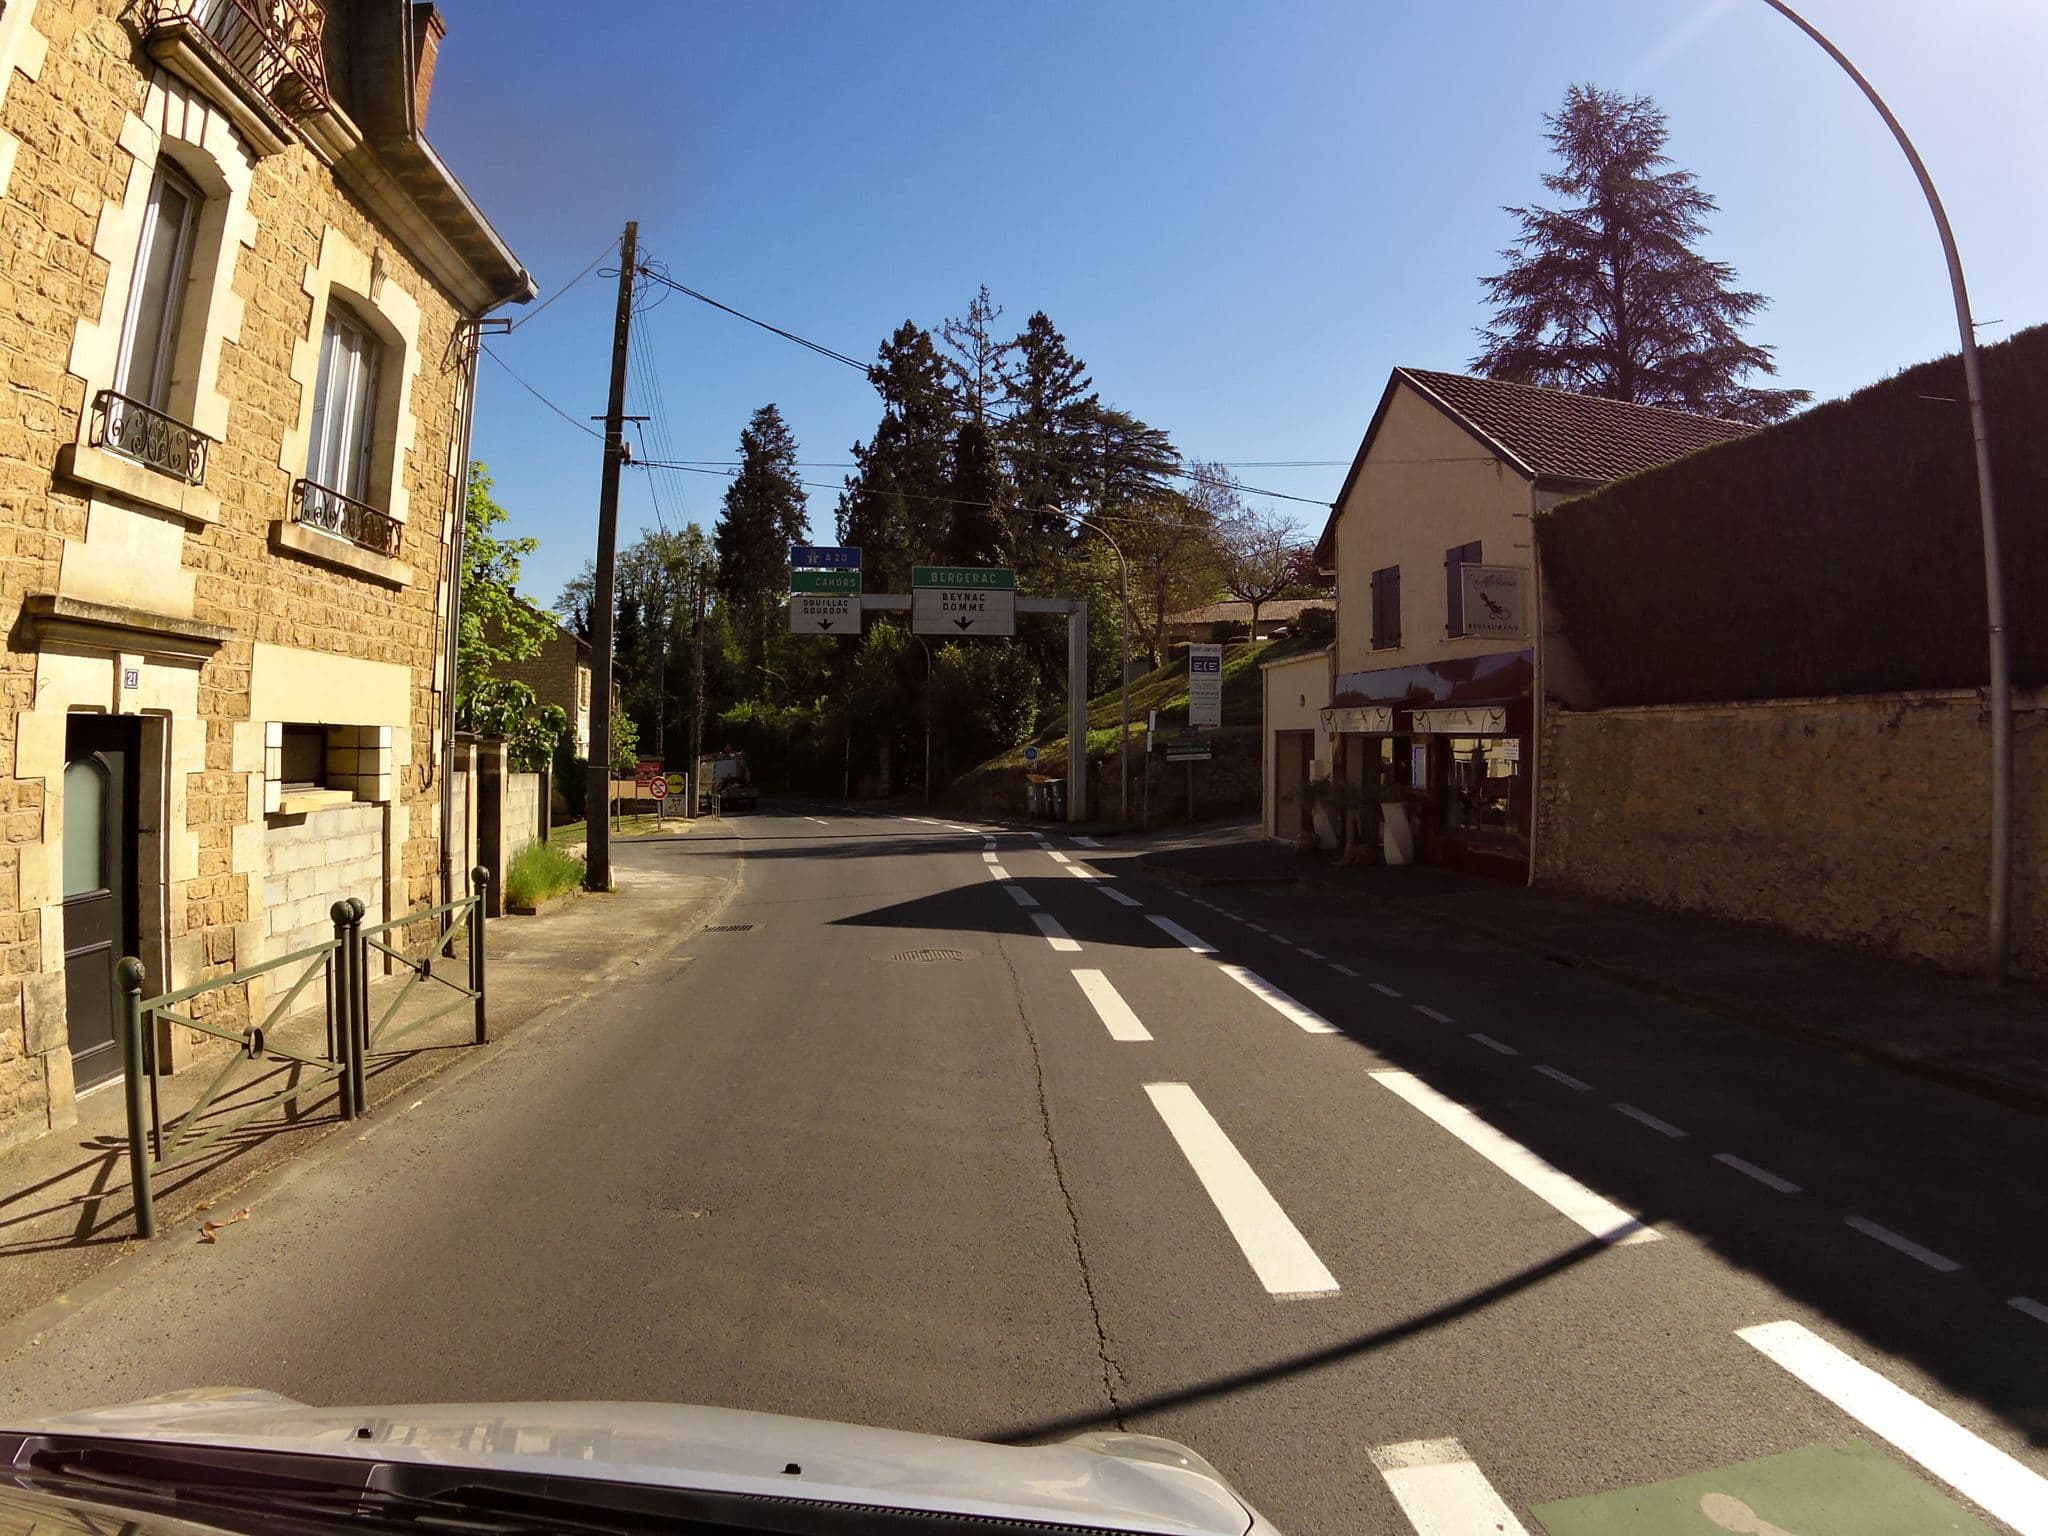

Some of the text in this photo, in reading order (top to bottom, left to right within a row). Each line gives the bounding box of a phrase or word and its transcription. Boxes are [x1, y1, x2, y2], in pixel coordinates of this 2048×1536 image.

[825, 553, 847, 562] A 20
[815, 577, 857, 588] CAHORS
[931, 572, 997, 584] BERGERAC
[942, 592, 986, 602] BEYNAC
[803, 599, 849, 607] SOUILLAC
[942, 602, 986, 612] DOMME
[803, 607, 849, 615] GOURDON
[1468, 623, 1518, 632] RESTAURANT
[127, 672, 137, 686] 21
